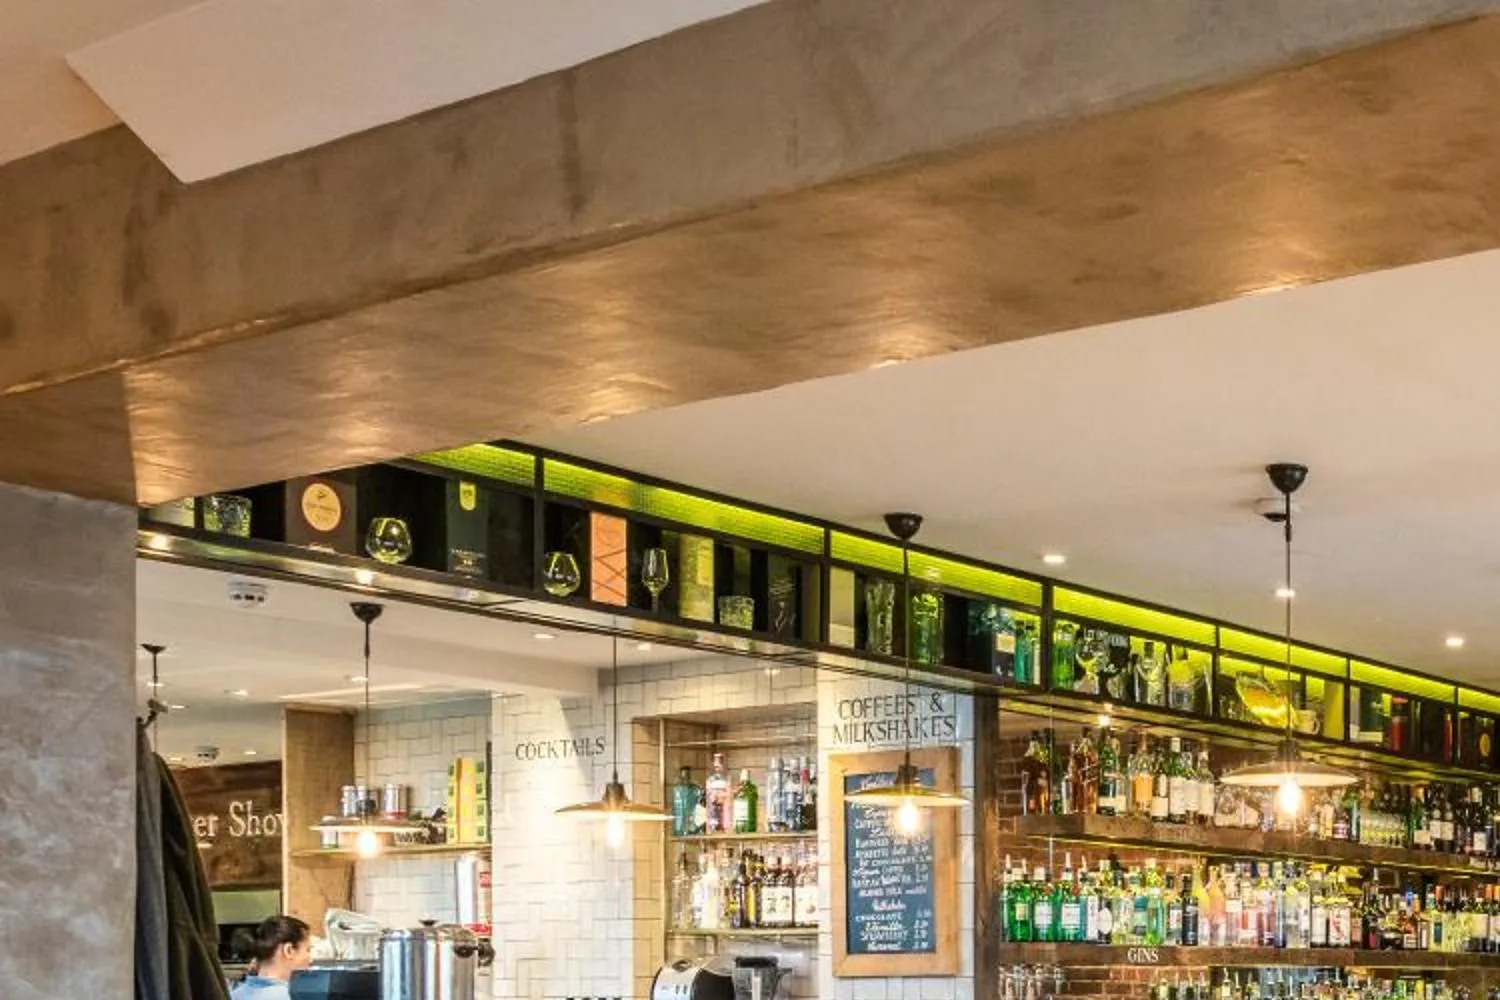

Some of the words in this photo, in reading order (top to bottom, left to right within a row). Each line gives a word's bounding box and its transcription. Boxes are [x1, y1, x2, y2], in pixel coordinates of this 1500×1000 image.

[838, 694, 915, 720] COFFEES
[930, 691, 944, 713] &
[833, 714, 956, 745] MILKSHAKES
[515, 735, 605, 761] COCKTAILS
[192, 814, 219, 837] er
[1127, 947, 1159, 964] GINS
